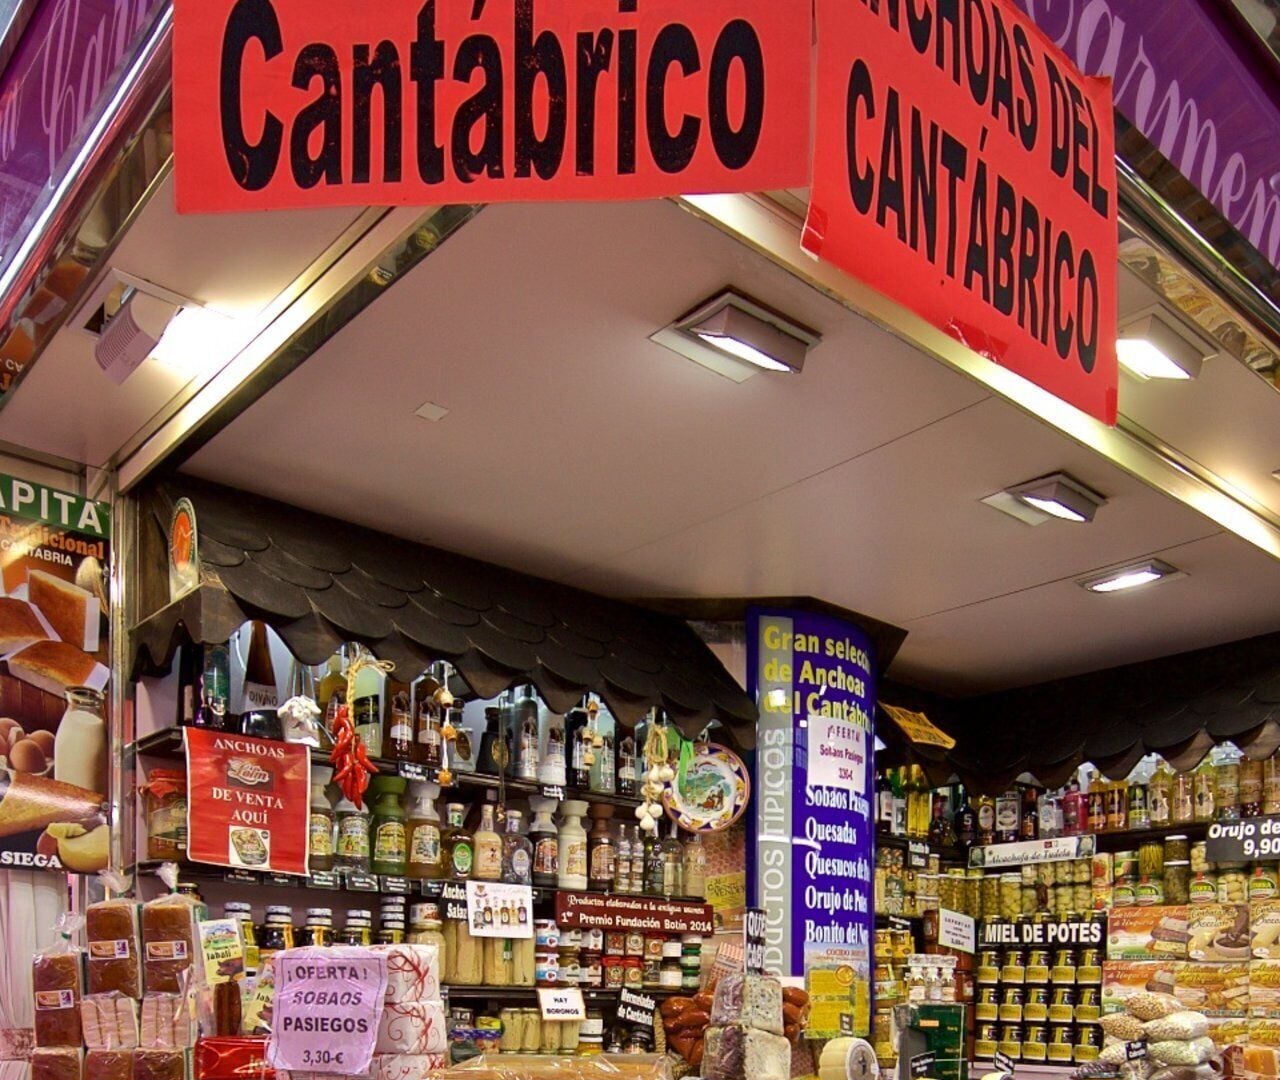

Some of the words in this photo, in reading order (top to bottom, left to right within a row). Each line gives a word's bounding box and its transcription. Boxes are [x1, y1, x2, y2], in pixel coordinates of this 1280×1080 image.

[1043, 53, 1109, 219] DEL
[845, 58, 1099, 374] CANTÁBRICO
[763, 625, 820, 654] Gran
[763, 658, 792, 683] de
[798, 660, 865, 699] Anchoas
[213, 737, 286, 760] ANCHOAS
[212, 787, 231, 801] DE
[235, 790, 284, 810] VENTA
[805, 786, 847, 809] Sobaos
[231, 809, 269, 825] AQUÍ
[805, 816, 857, 846] Quesadas
[1208, 822, 1256, 842] Orujo
[805, 850, 856, 880] Quesucos
[442, 883, 467, 900] Ancho
[805, 885, 841, 916] Orujo
[579, 913, 613, 926] Premio
[615, 914, 661, 929] Fundación
[690, 920, 712, 932] 2014
[805, 919, 845, 943] Bonito
[984, 923, 1020, 943] MIEL
[1022, 924, 1044, 943] DE
[1047, 922, 1102, 943] POTES
[292, 991, 363, 1006] SOBAOS
[283, 1016, 369, 1034] PASIEGOS
[303, 1050, 344, 1066] 3,30-€
